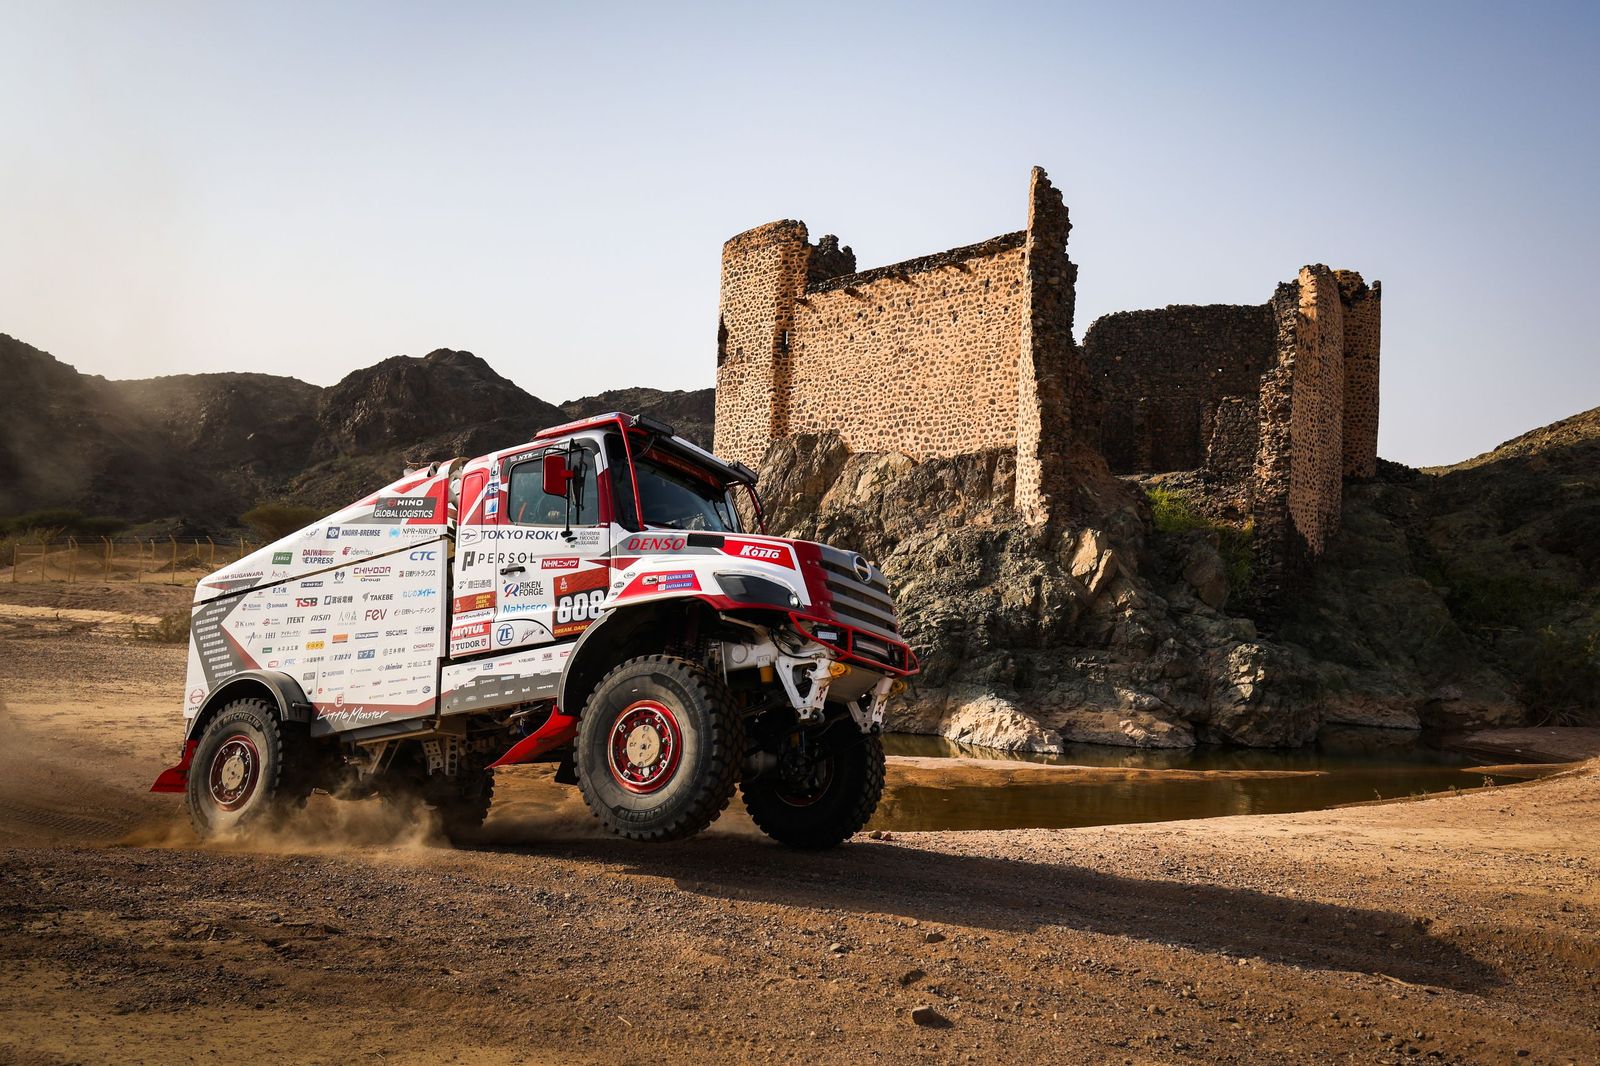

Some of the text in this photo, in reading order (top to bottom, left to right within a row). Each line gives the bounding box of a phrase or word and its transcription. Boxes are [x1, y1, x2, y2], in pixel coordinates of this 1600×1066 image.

[374, 510, 433, 518] GLOBAL LOGISTICS
[341, 529, 381, 537] KNORR-BREMSE
[481, 530, 559, 540] TOKYO ROKI
[627, 537, 686, 551] DENSO
[304, 557, 334, 565] EXPRESS
[409, 551, 437, 561] CTC
[478, 552, 537, 564] PERSOL
[231, 571, 263, 579] SUGAWARA
[519, 581, 541, 590] RIKEN
[519, 588, 544, 597] FORGE
[295, 597, 318, 608] TSB
[557, 589, 605, 624] 608
[286, 616, 305, 624] JTEKT
[453, 624, 485, 638] MOTUL
[499, 628, 512, 642] ZF
[456, 639, 480, 650] TUDOR
[223, 712, 261, 729] MICHELIN
